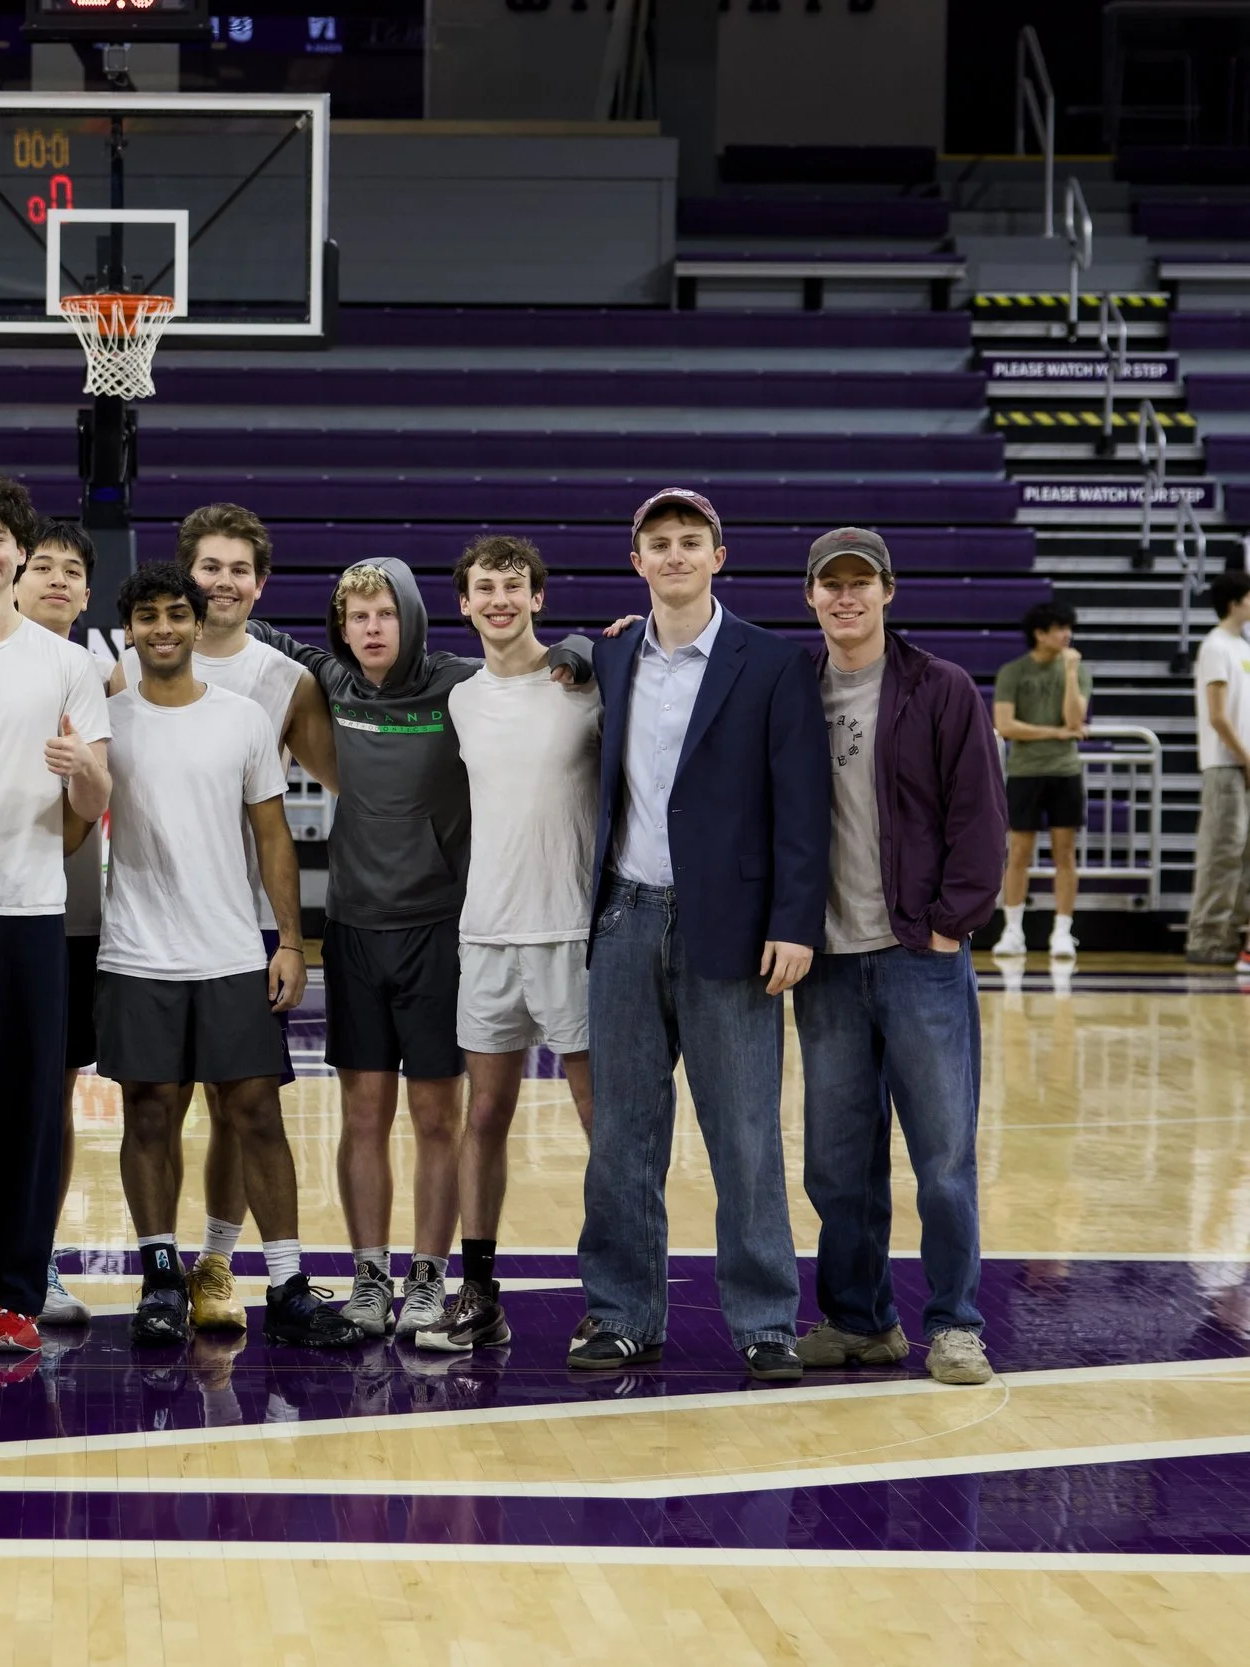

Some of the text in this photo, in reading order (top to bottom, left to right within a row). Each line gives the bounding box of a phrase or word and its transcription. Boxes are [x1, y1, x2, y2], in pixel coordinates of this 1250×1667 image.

[993, 361, 1046, 378] PLEASE
[1046, 361, 1094, 378] WATCH
[1133, 362, 1168, 378] STEP
[1023, 486, 1077, 502] PLEASE
[1078, 487, 1128, 502] WATCH
[1168, 487, 1205, 503] STEP
[333, 704, 443, 722] ROLAND
